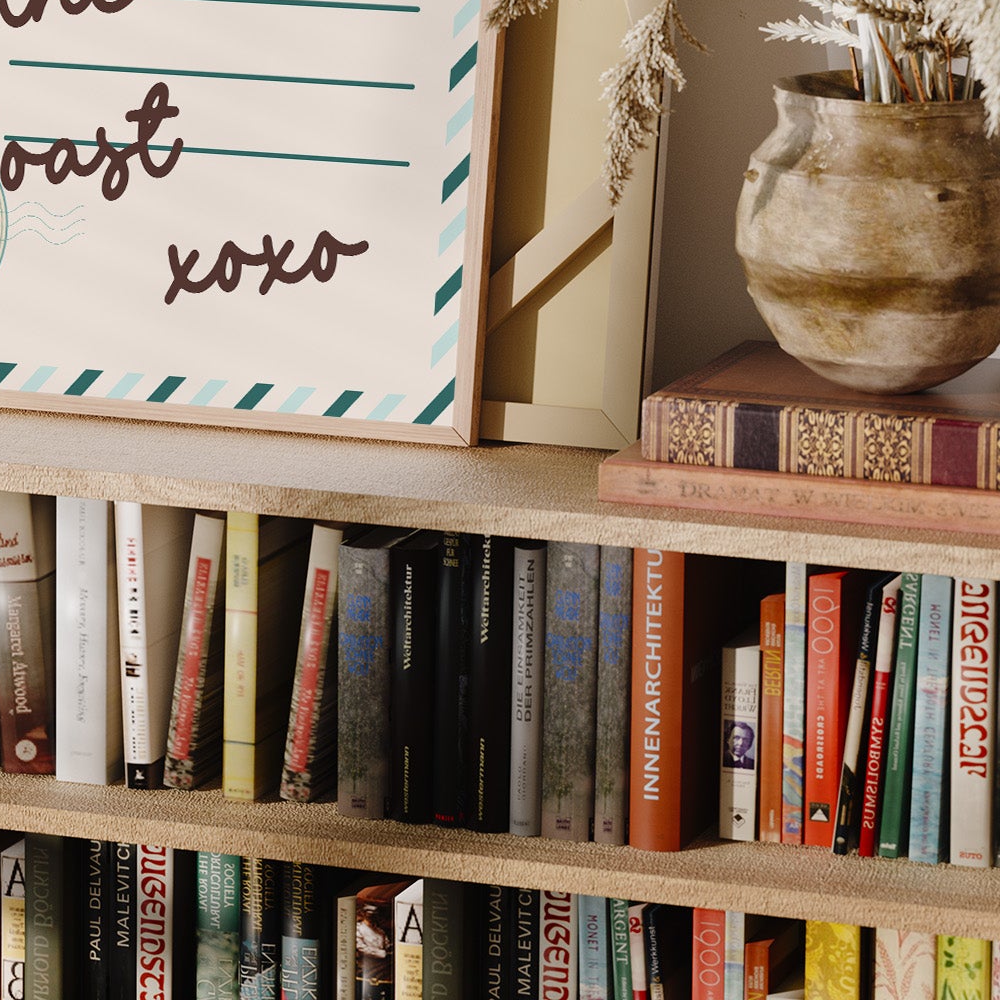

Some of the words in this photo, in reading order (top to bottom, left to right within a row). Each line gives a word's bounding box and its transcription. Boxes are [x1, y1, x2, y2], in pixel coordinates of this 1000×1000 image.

[164, 230, 369, 305] xoxo
[7, 594, 24, 658] Margaret
[403, 564, 413, 671] Weltarchitektur
[516, 574, 525, 687] EINSAMKEIT
[525, 558, 535, 679] PRIMZAHLEN
[12, 660, 30, 716] Atwood
[524, 685, 532, 722] DER
[643, 548, 664, 801] INNENARCHITEKTU
[478, 737, 486, 821] westermann
[89, 841, 101, 912] DELVAU
[89, 920, 101, 962] PAUL
[587, 915, 598, 952] MONET
[648, 925, 659, 974] Werkkunst
[695, 921, 721, 987] 1900
